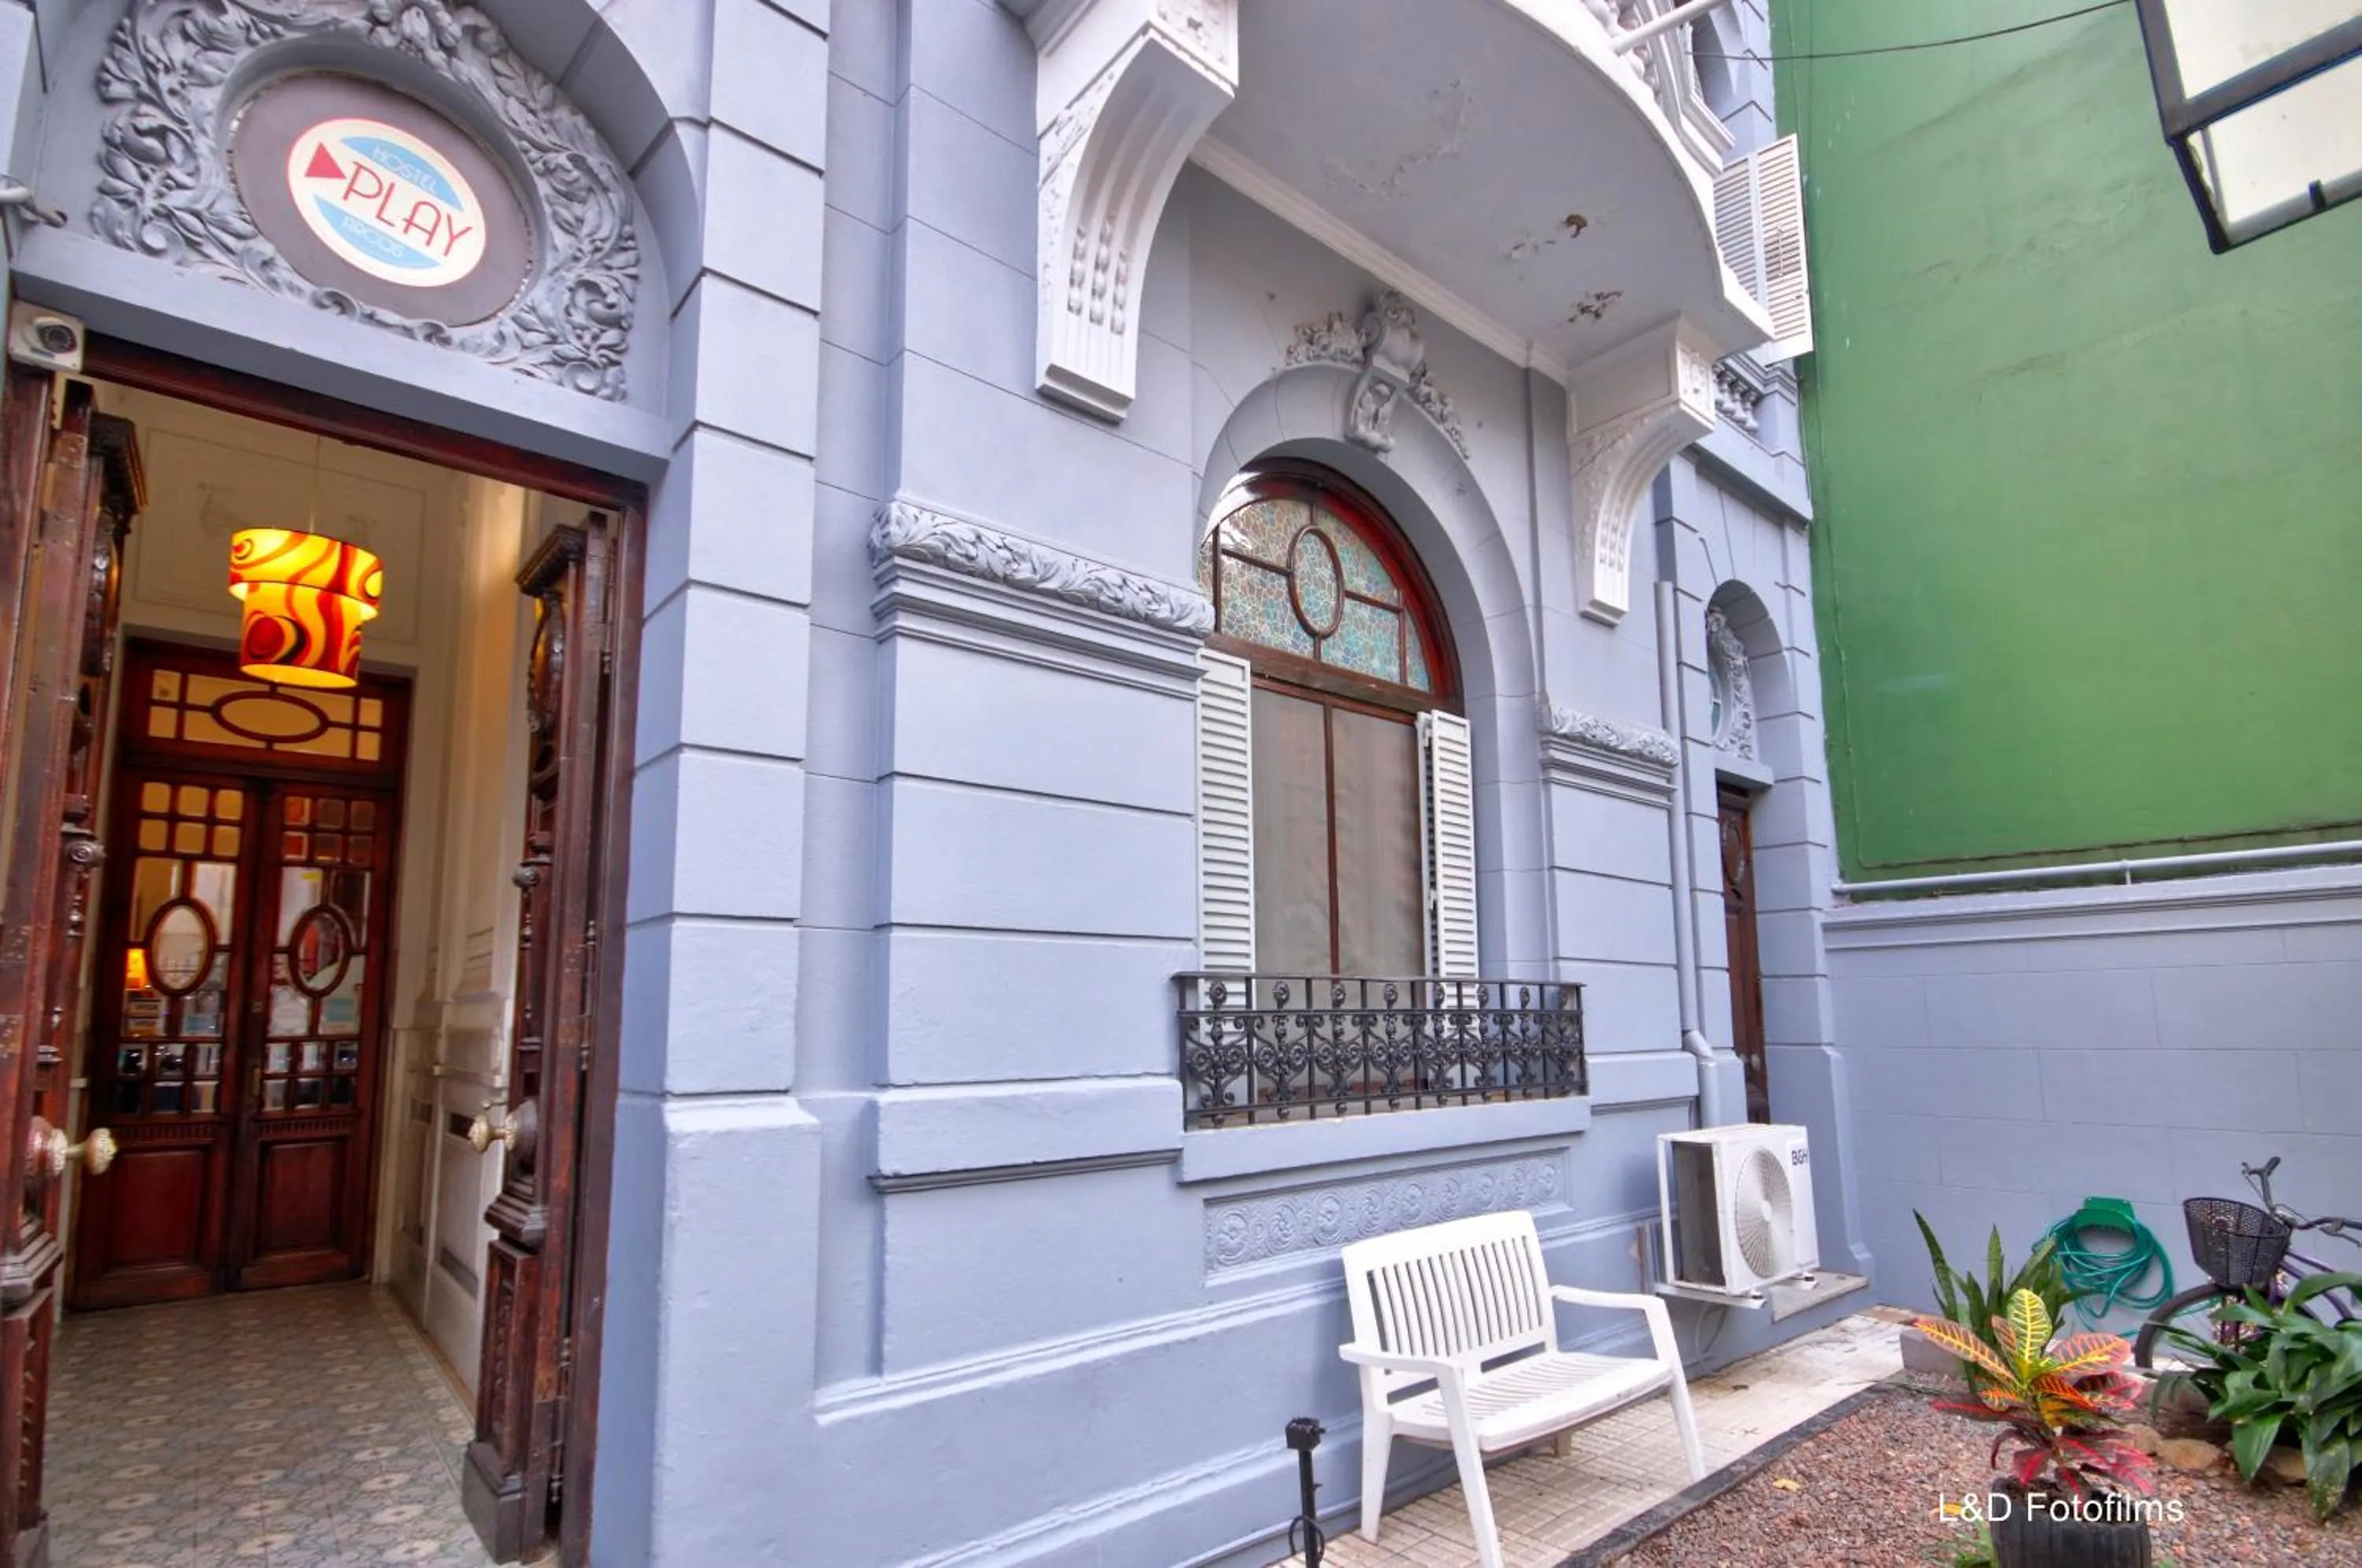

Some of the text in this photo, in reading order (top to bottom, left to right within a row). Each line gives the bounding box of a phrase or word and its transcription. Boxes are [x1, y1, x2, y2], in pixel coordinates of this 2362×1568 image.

[371, 146, 438, 191] HOSTEL
[342, 161, 472, 257] PLAY
[1791, 1148, 1809, 1166] BGH
